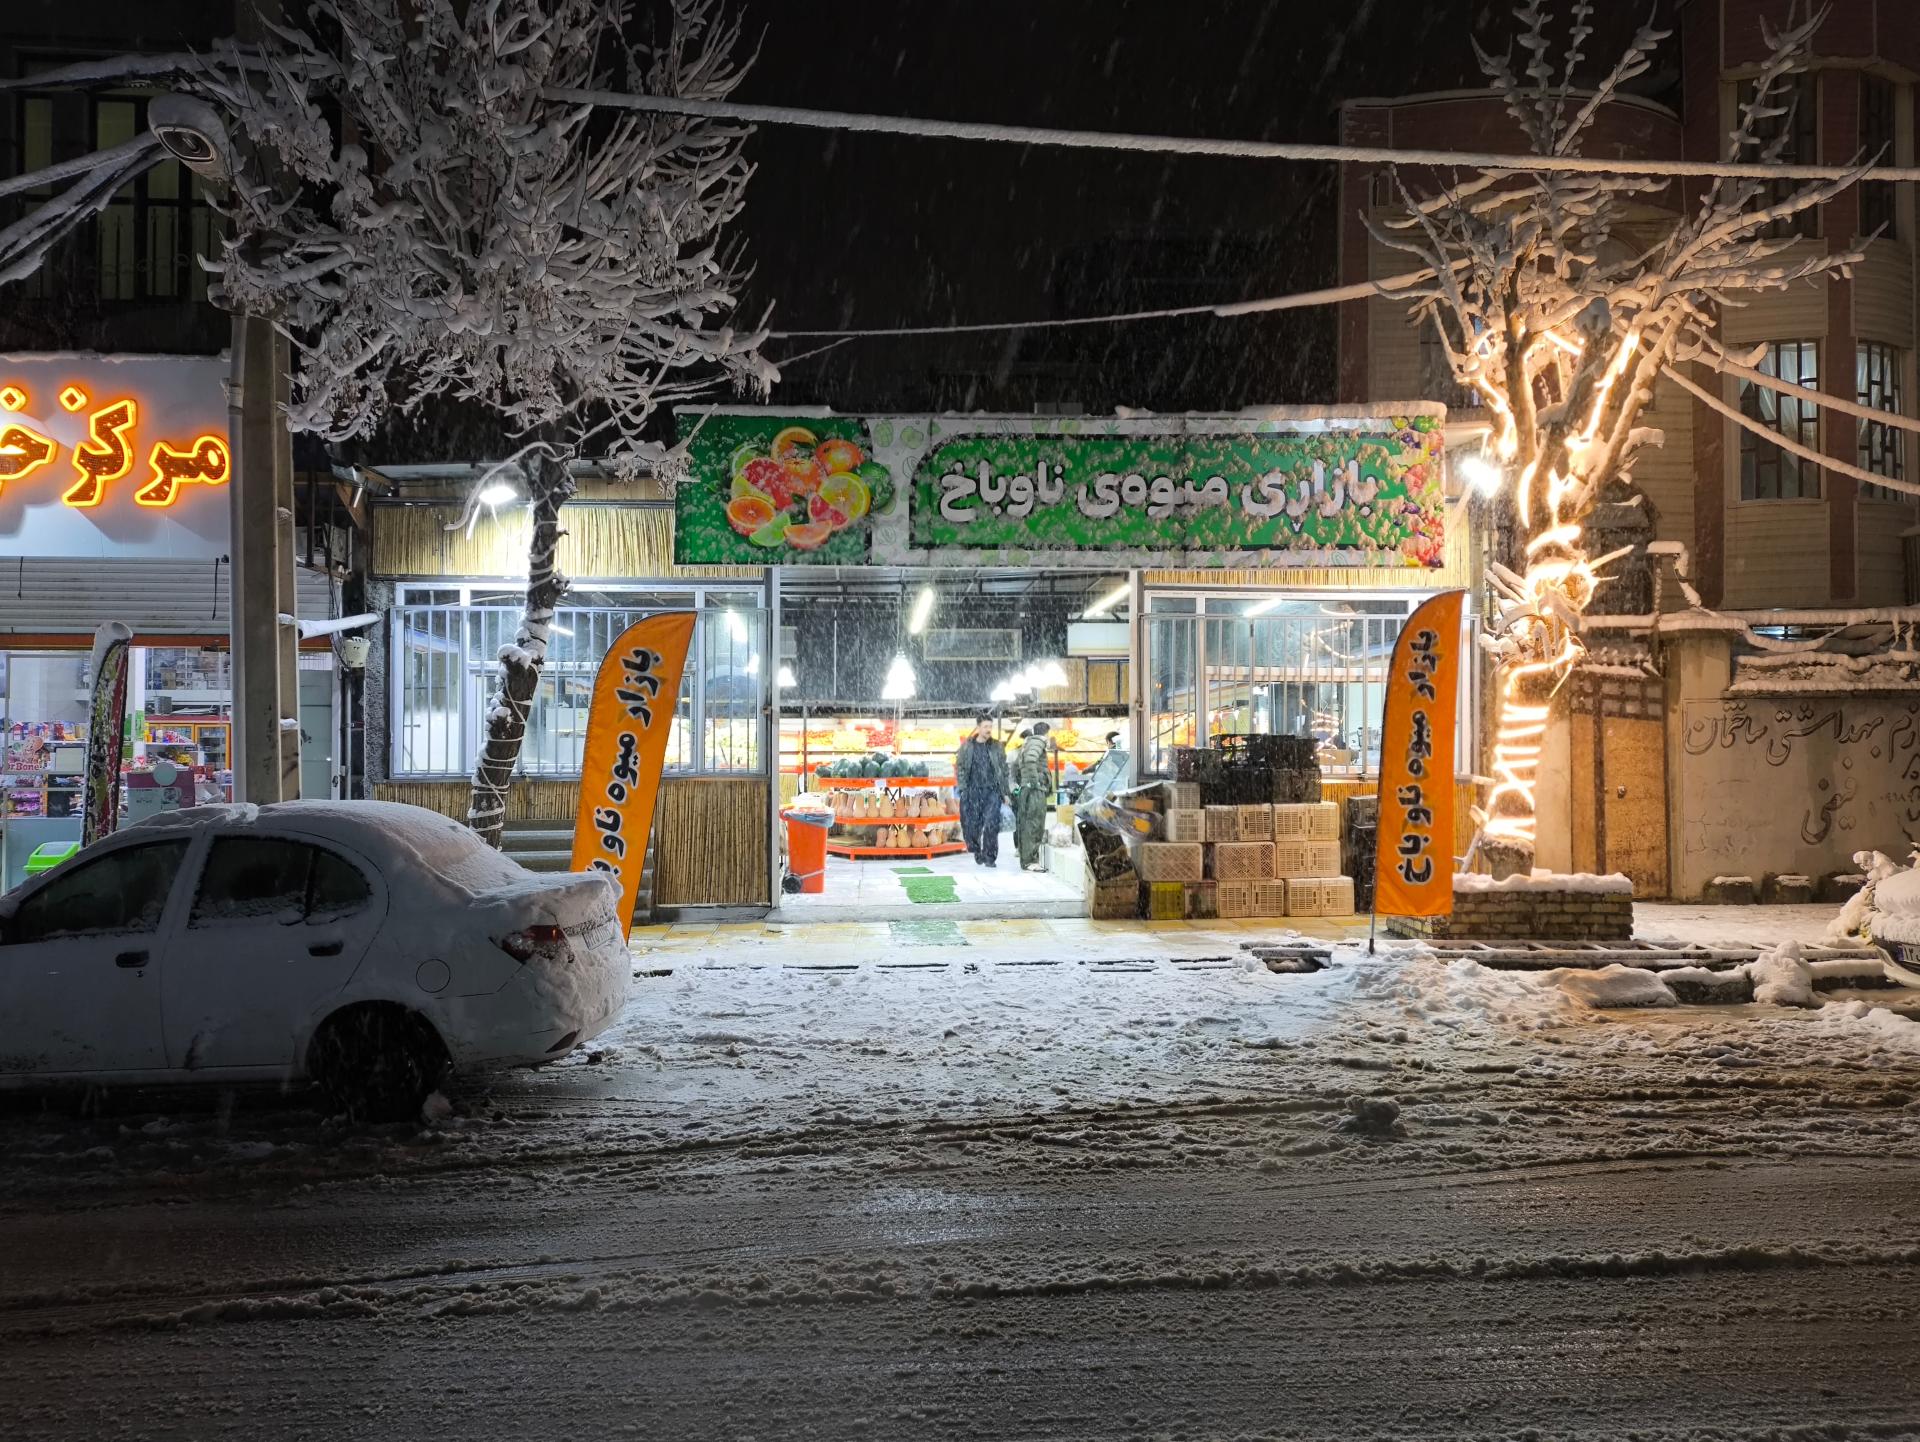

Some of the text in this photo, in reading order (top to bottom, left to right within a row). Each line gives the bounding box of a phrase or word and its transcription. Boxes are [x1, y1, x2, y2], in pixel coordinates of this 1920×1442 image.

[60, 386, 230, 506] مرکز
[940, 459, 1065, 523] ناوباخ
[614, 648, 661, 729] بازار
[1408, 630, 1438, 702] بازار
[1407, 710, 1432, 776] میوه
[1684, 701, 1769, 755] ساختمان
[1766, 701, 1884, 766] بهداشتی
[607, 732, 640, 804] میوه
